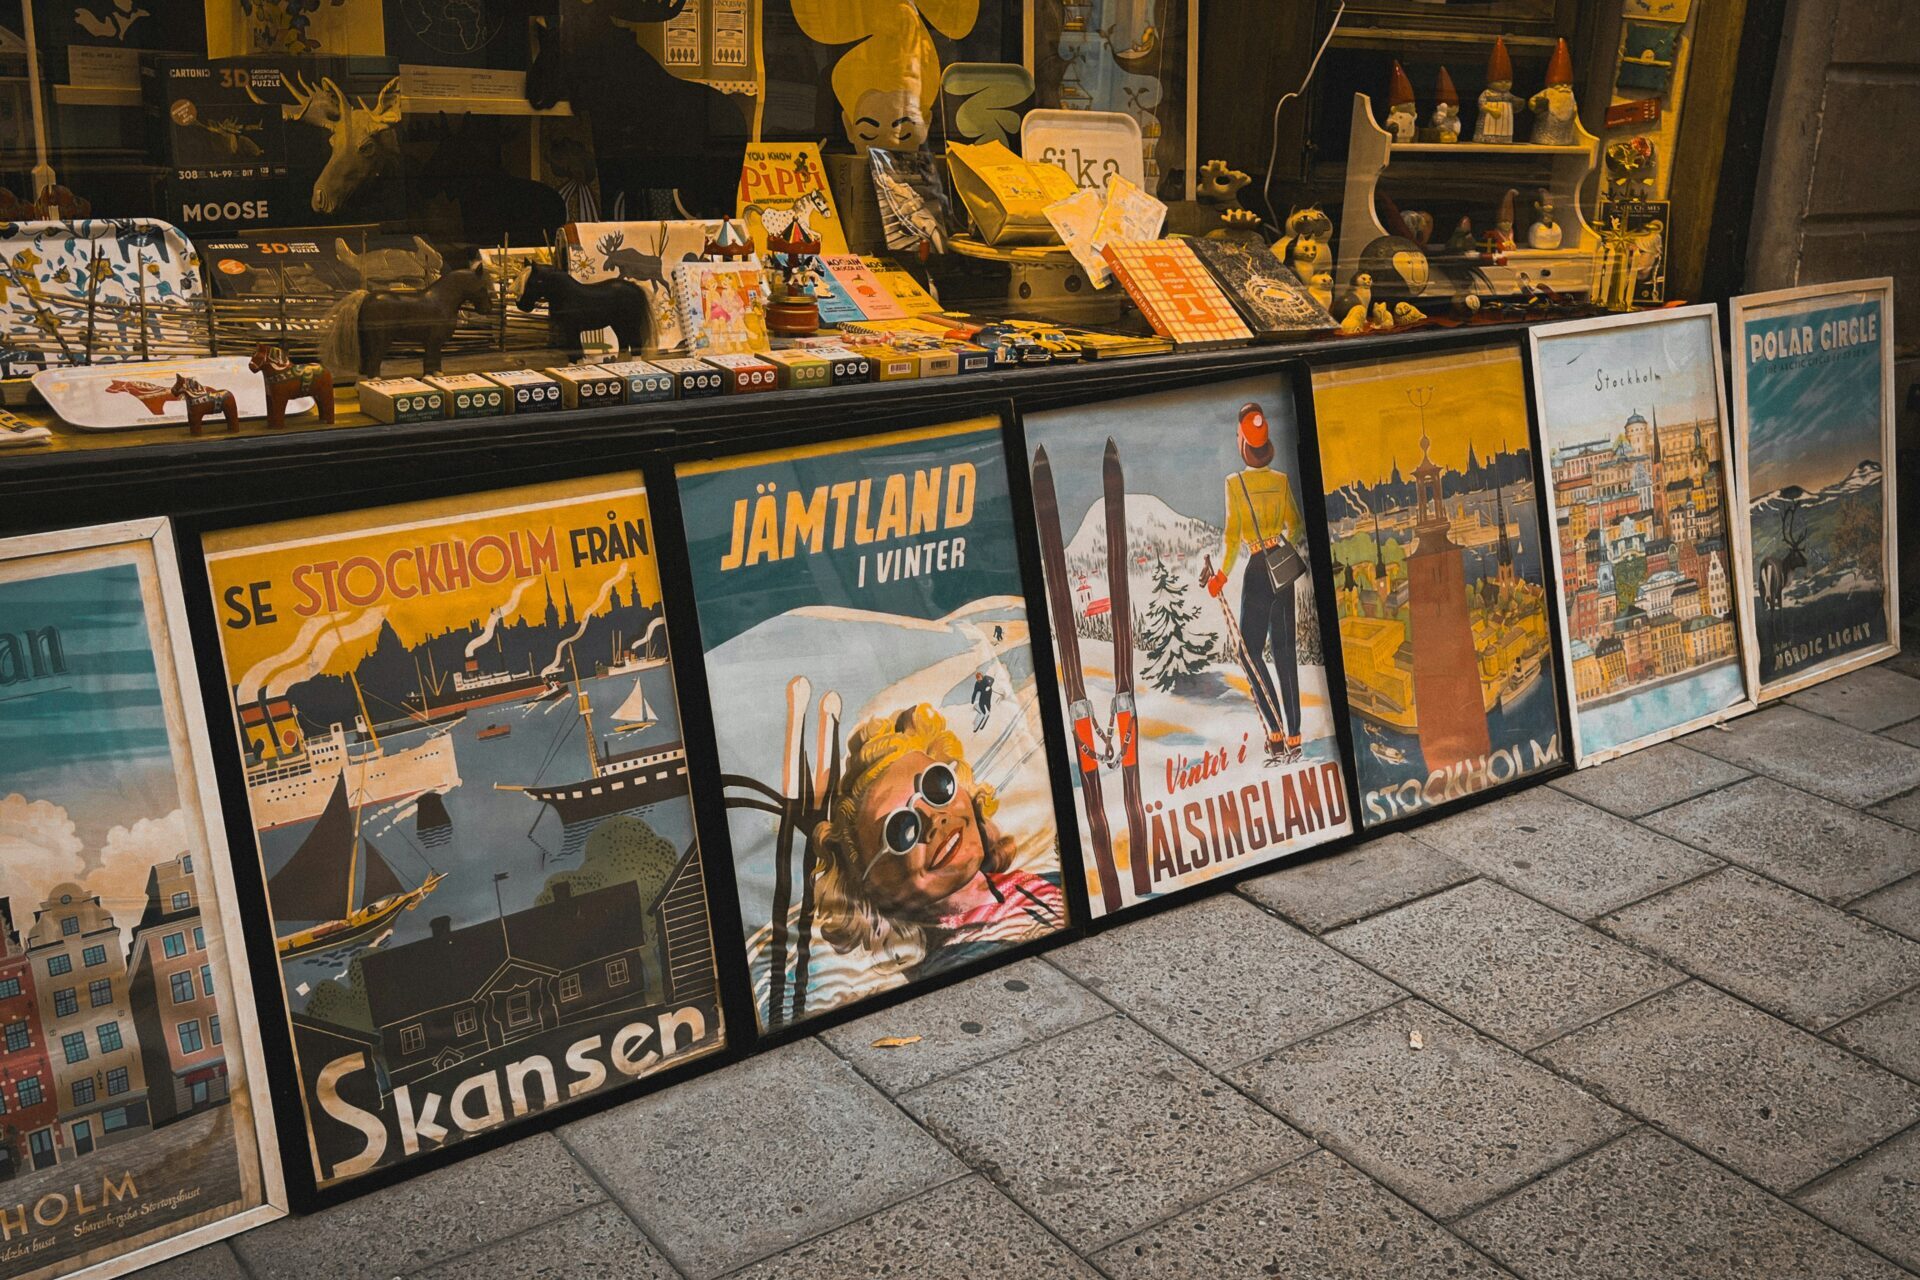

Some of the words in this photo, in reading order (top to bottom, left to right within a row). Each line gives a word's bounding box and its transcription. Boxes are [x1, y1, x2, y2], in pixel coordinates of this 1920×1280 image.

[219, 67, 250, 88] 3D
[178, 170, 198, 180] 308
[209, 169, 233, 179] 14-99
[747, 152, 765, 160] YOU
[768, 152, 792, 160] KNOW
[182, 200, 269, 222] MOOSE
[256, 243, 288, 254] 3D
[1750, 325, 1814, 363] POLAR
[1820, 313, 1877, 351] CIRCLE
[1594, 366, 1662, 392] Stockholm
[721, 462, 977, 572] JÄMTLAND
[224, 580, 277, 630] SE
[292, 525, 560, 617] STOCKHOLM
[570, 510, 650, 568] FRÅN
[858, 554, 866, 588] I
[876, 536, 967, 584] VINTER
[1774, 637, 1823, 671] NORDIC
[1828, 622, 1871, 651] LIGHT
[1166, 747, 1229, 795] Vinter
[1237, 732, 1249, 764] i
[1363, 733, 1560, 823] STOCKHOLM
[315, 1005, 706, 1180] Skansen
[0, 1170, 139, 1241] HOLM
